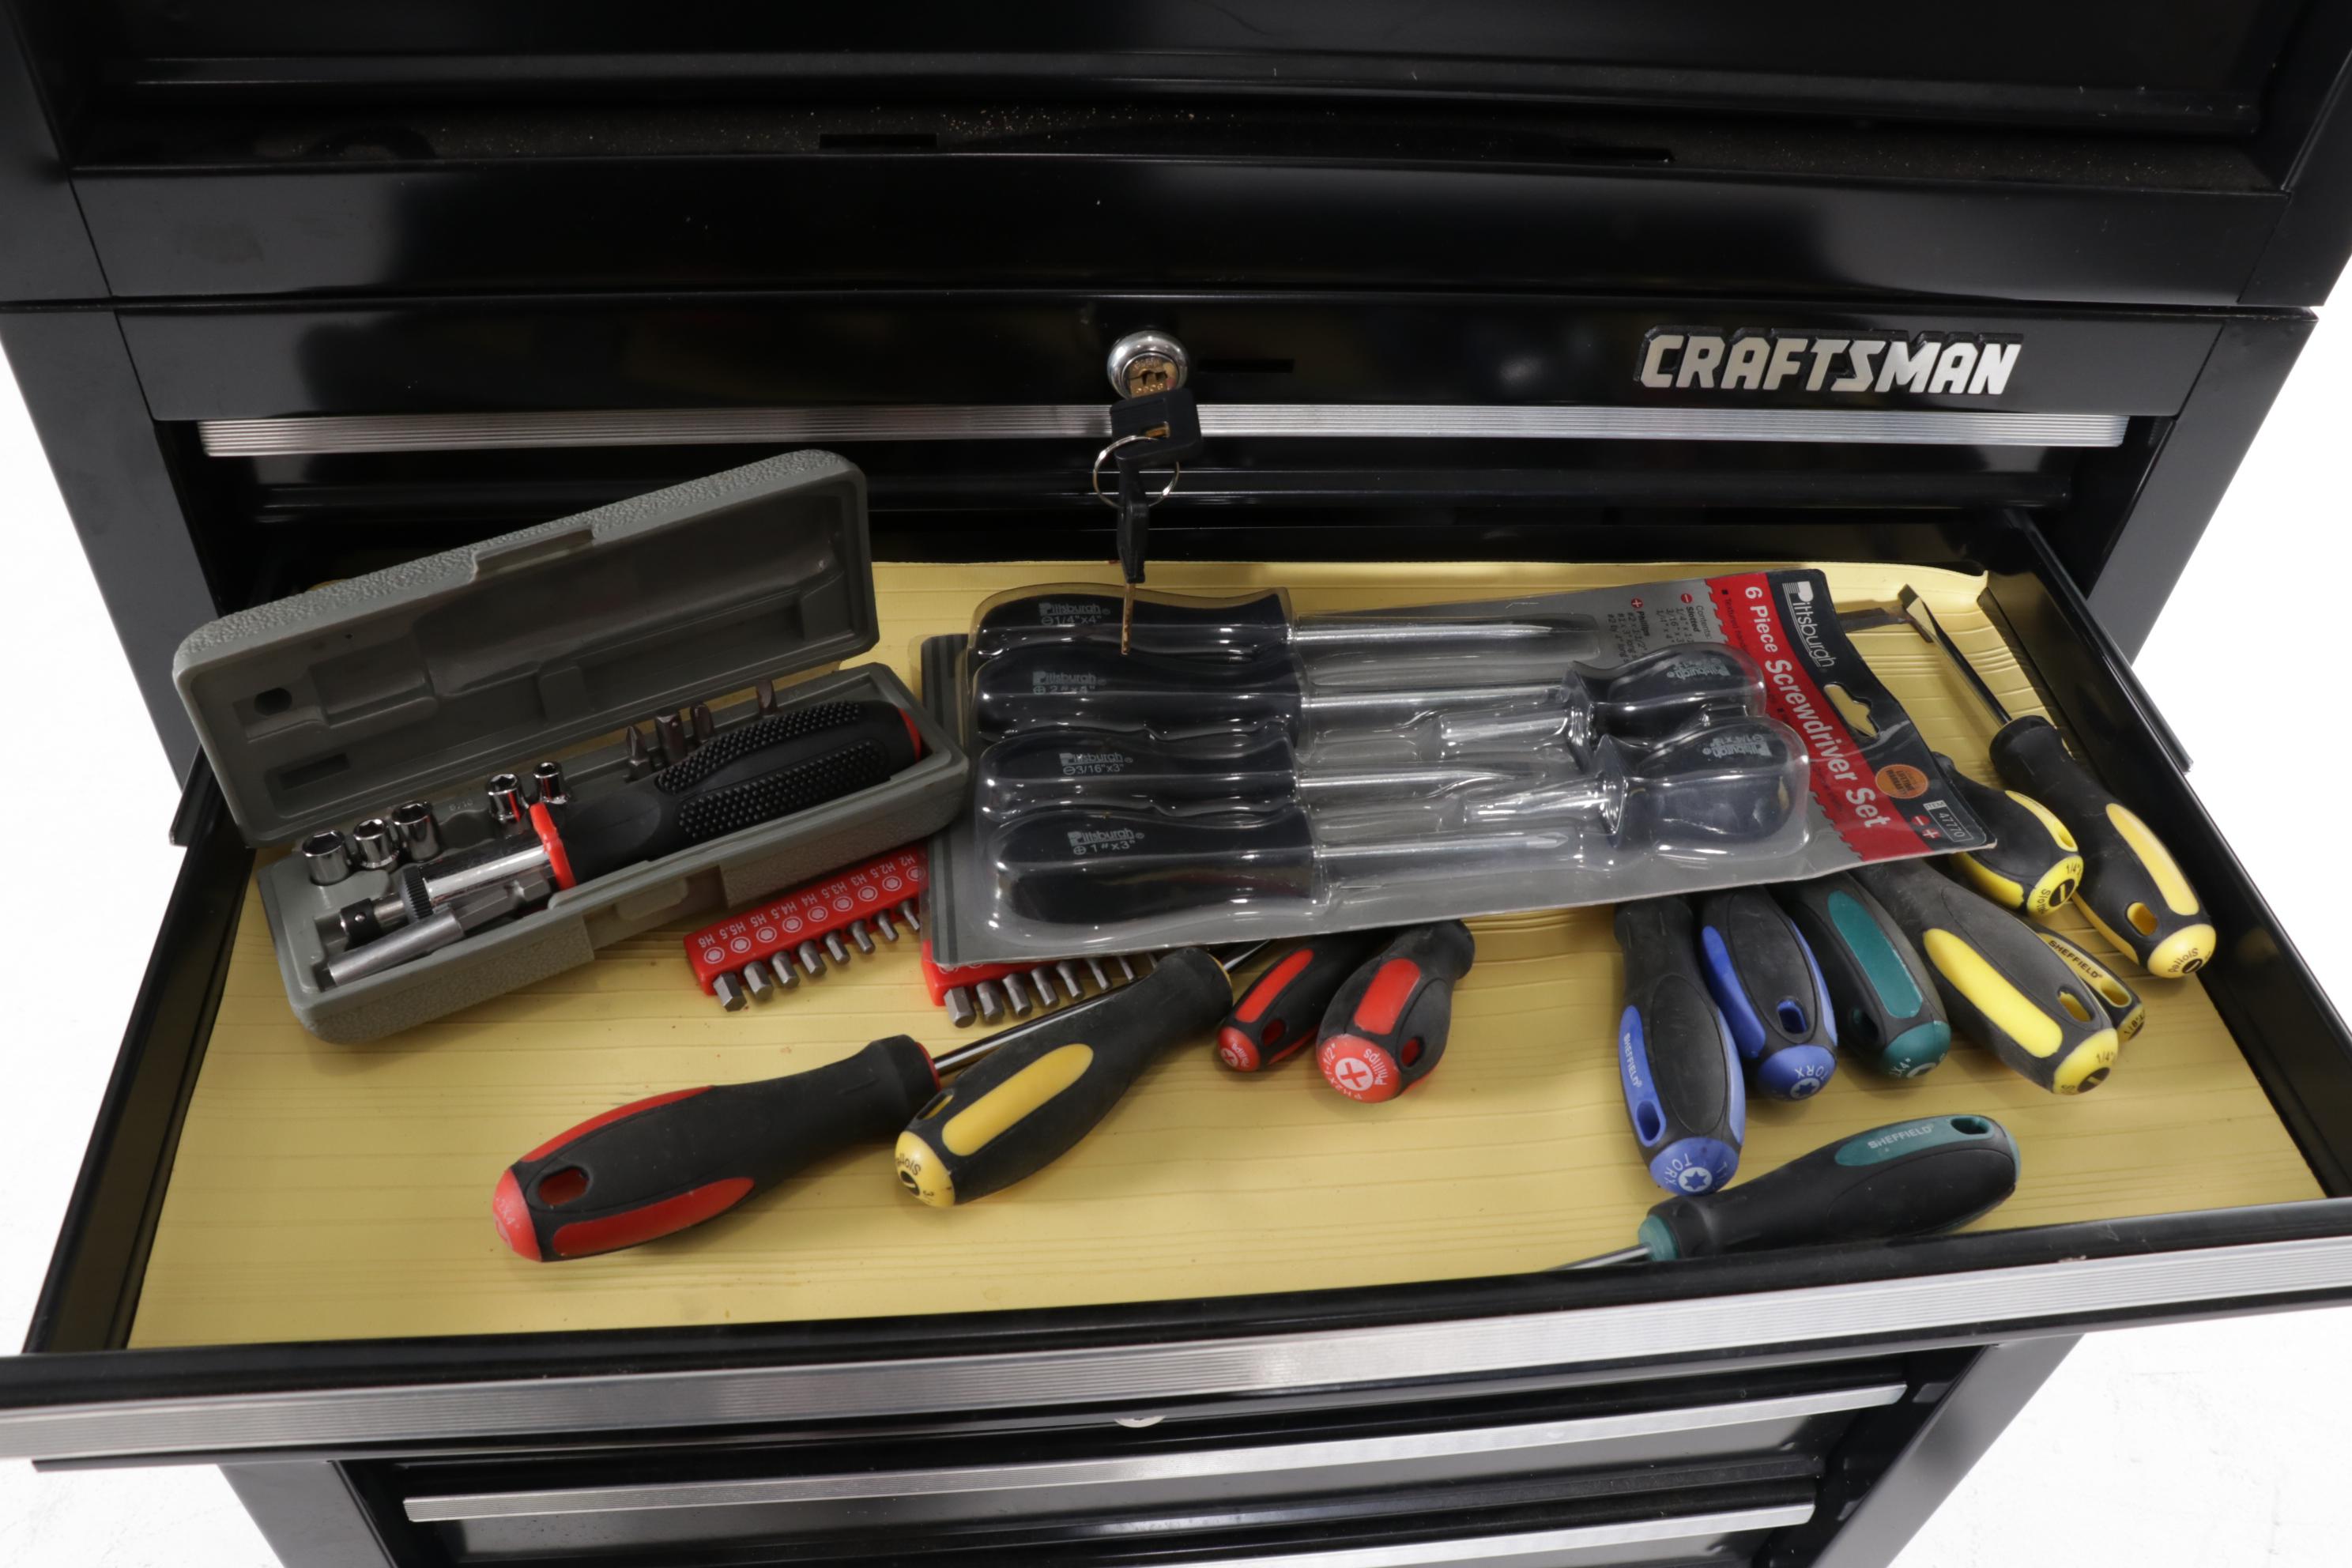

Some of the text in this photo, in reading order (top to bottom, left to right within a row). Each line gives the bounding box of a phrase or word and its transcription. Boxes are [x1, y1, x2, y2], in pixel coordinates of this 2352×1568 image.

[1640, 333, 2022, 395] CRAFTSMAN
[1745, 586, 1763, 599] 6
[1038, 603, 1102, 616] Pittsburgh
[1686, 606, 1700, 632] Slotted
[1696, 605, 1712, 639] Contents:
[1637, 611, 1650, 637] Phillips
[1750, 605, 1778, 653] Piece
[1784, 581, 1837, 667] Pittsburgh
[1033, 671, 1096, 685] Pittsburgh
[1765, 660, 1858, 780] Screwdriver
[1060, 752, 1124, 767] Pittsburgh
[1845, 787, 1890, 827] Set
[1925, 801, 1947, 809] ITEM
[1068, 828, 1135, 846] Pittsburgh
[1939, 812, 1966, 838] 47770
[699, 854, 916, 948] H2 H2.5 H3 H3.5 H4 H4.5 H5 H5.5 H6
[2048, 940, 2099, 978] SHEFFIELD
[2168, 948, 2200, 973] Slotted
[1363, 1048, 1389, 1086] Phillips
[1624, 1033, 1639, 1085] SHEFFIELD
[1794, 1064, 1829, 1081] TORX
[1868, 1125, 1932, 1148] SHEFFIELD
[1664, 1152, 1693, 1186] TORX
